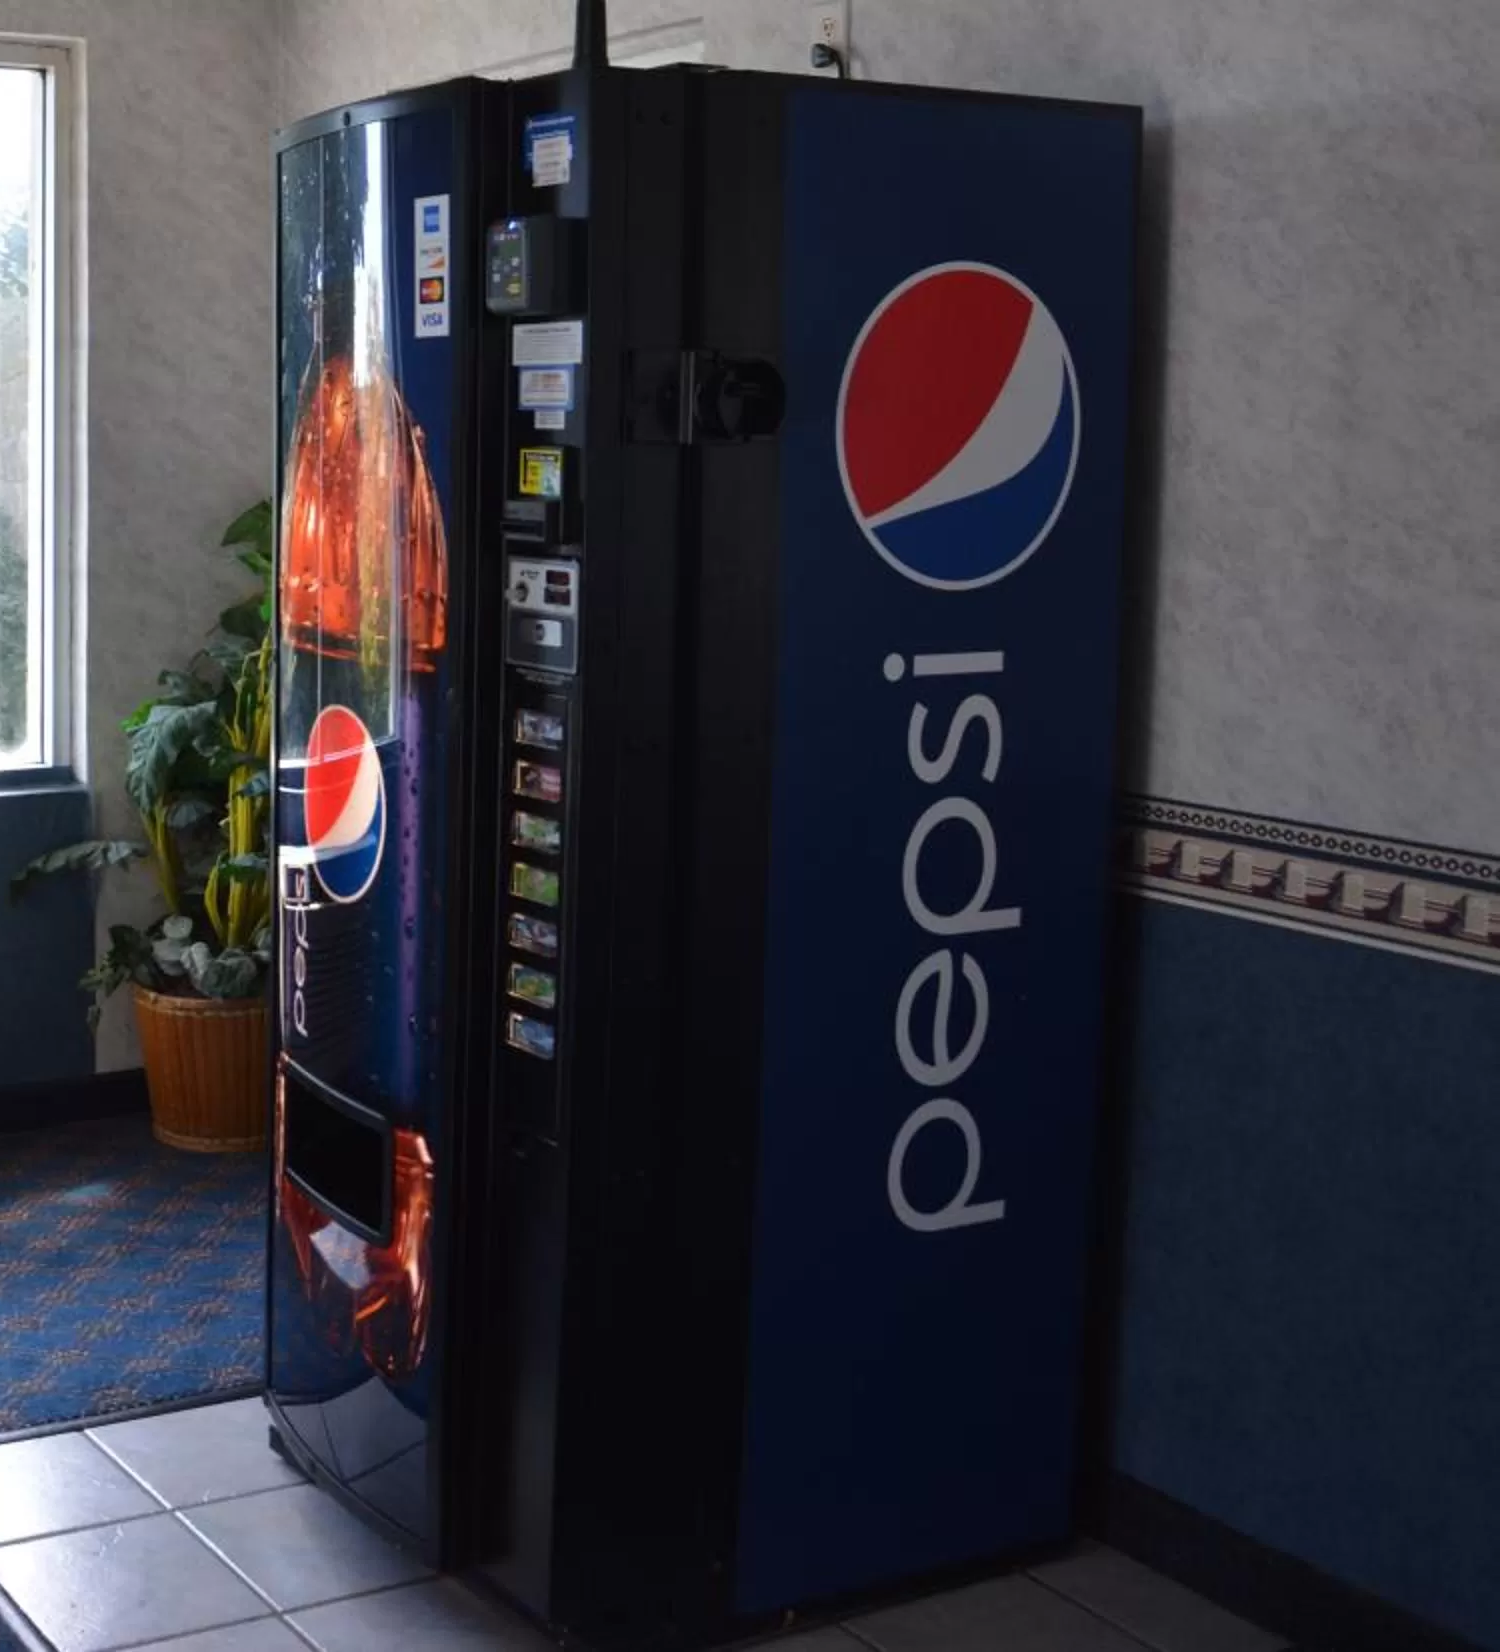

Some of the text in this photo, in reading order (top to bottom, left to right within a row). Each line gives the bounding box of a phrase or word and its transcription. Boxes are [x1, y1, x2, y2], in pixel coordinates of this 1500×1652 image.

[421, 313, 443, 327] VISA
[293, 852, 309, 1037] peps
[883, 650, 1022, 1233] pepsi
